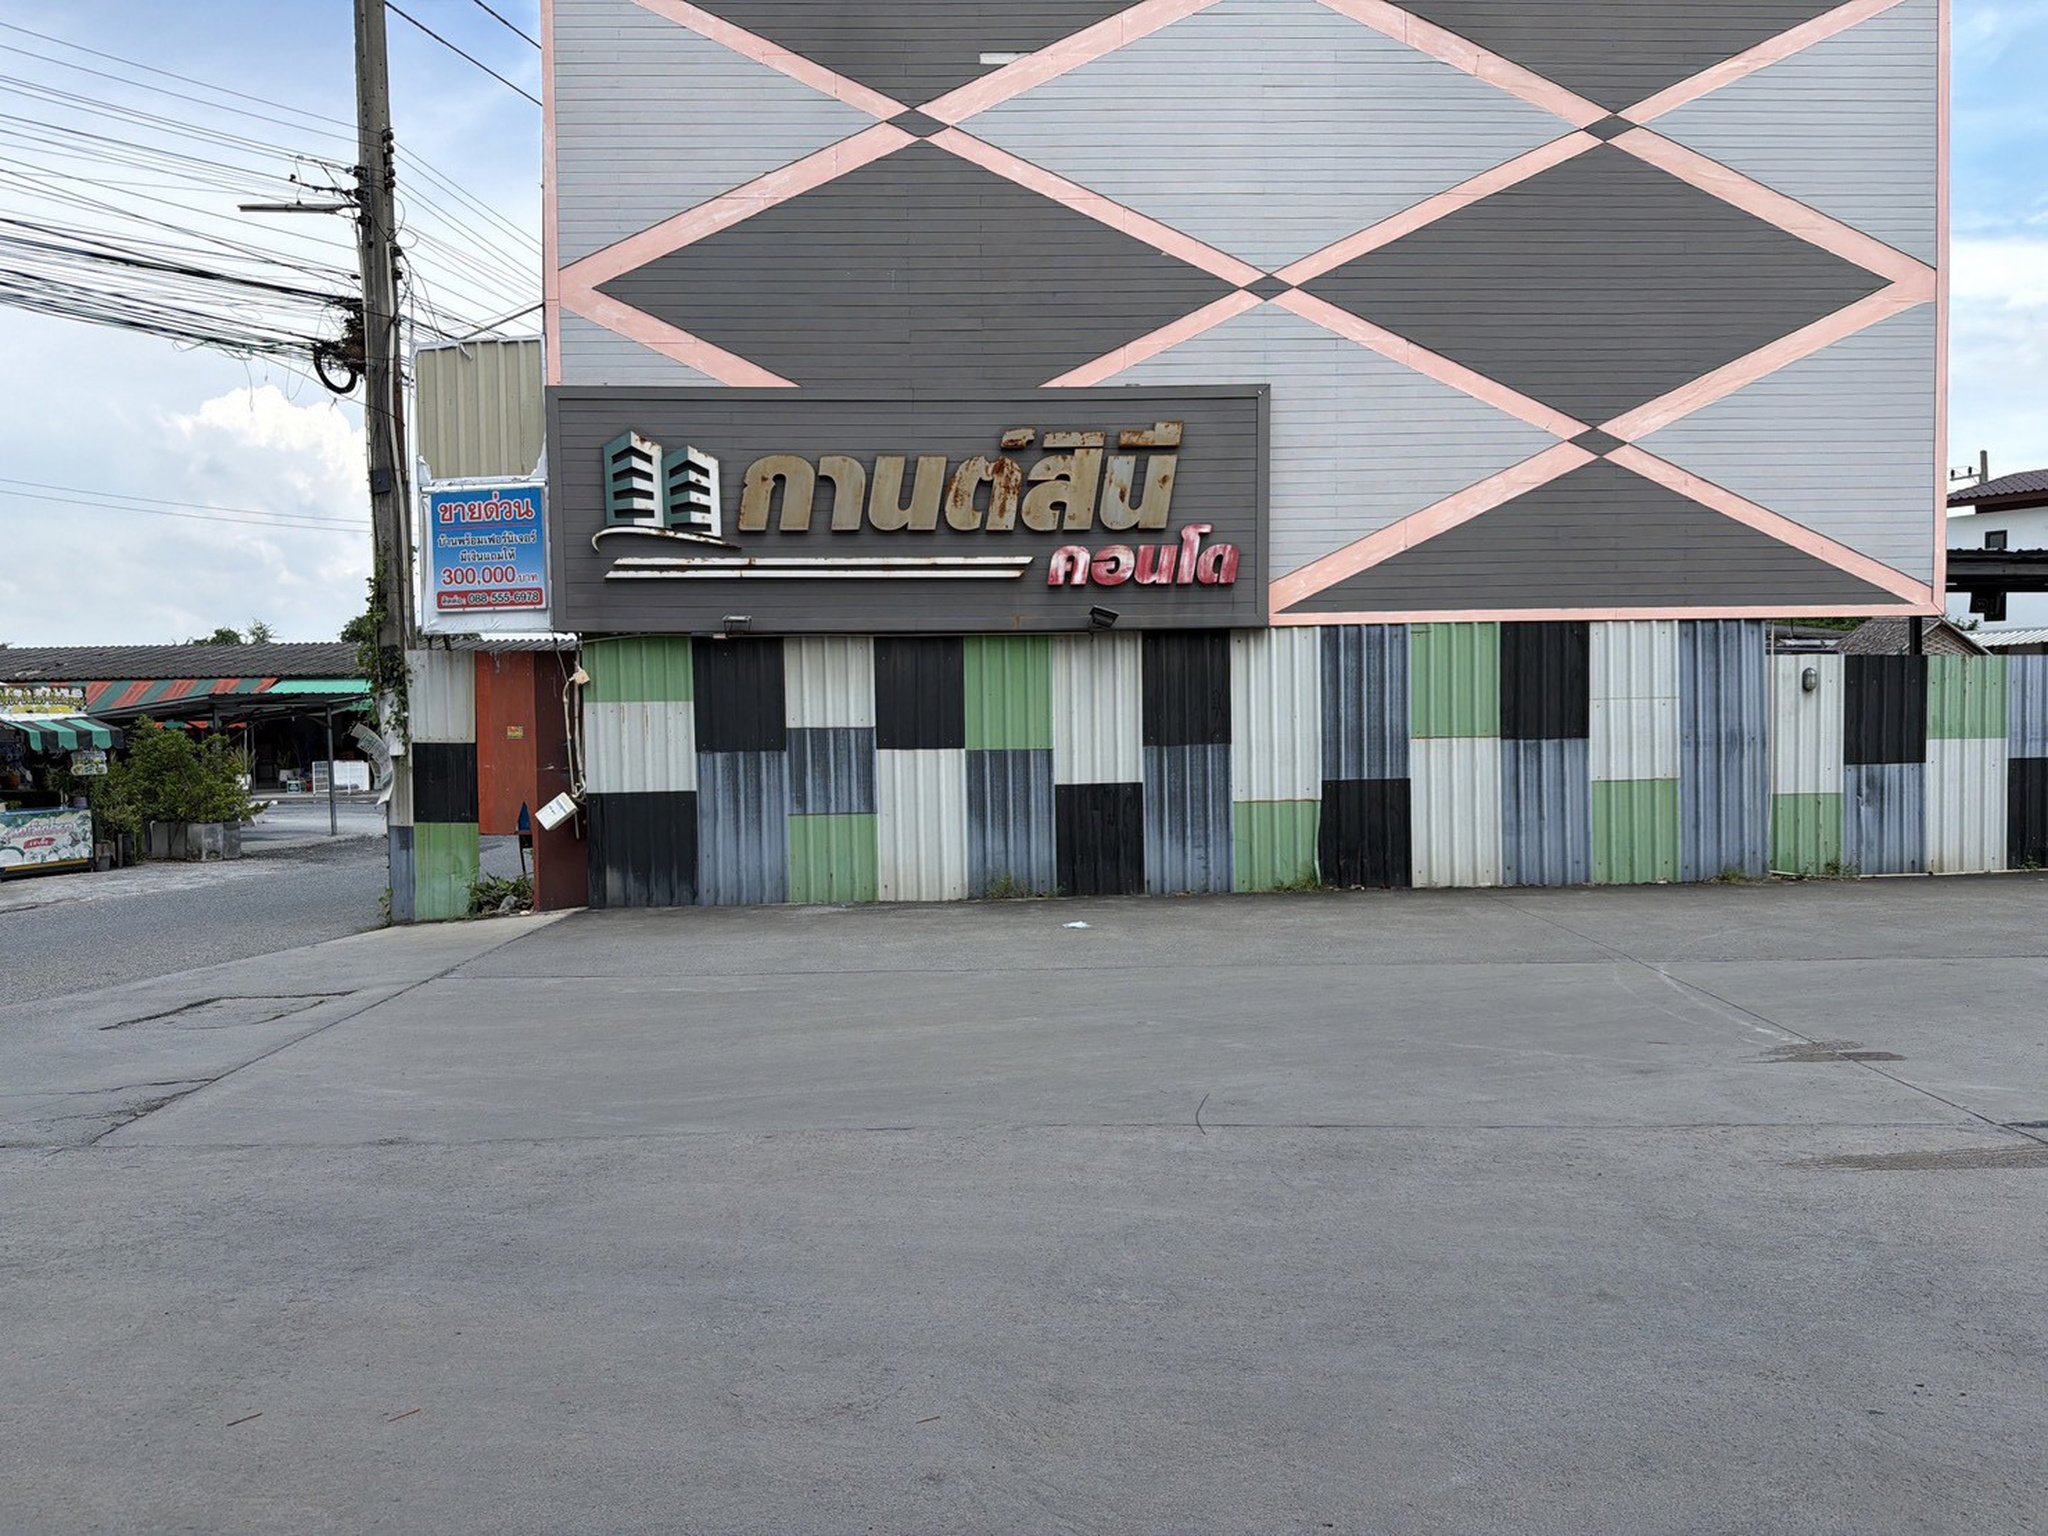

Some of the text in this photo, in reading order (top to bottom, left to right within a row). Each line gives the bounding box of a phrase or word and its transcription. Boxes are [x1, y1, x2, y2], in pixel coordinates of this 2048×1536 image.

[438, 492, 535, 523] ขายด่วน
[1047, 523, 1240, 586] คอนโด
[442, 566, 538, 585] 300,000 บาท
